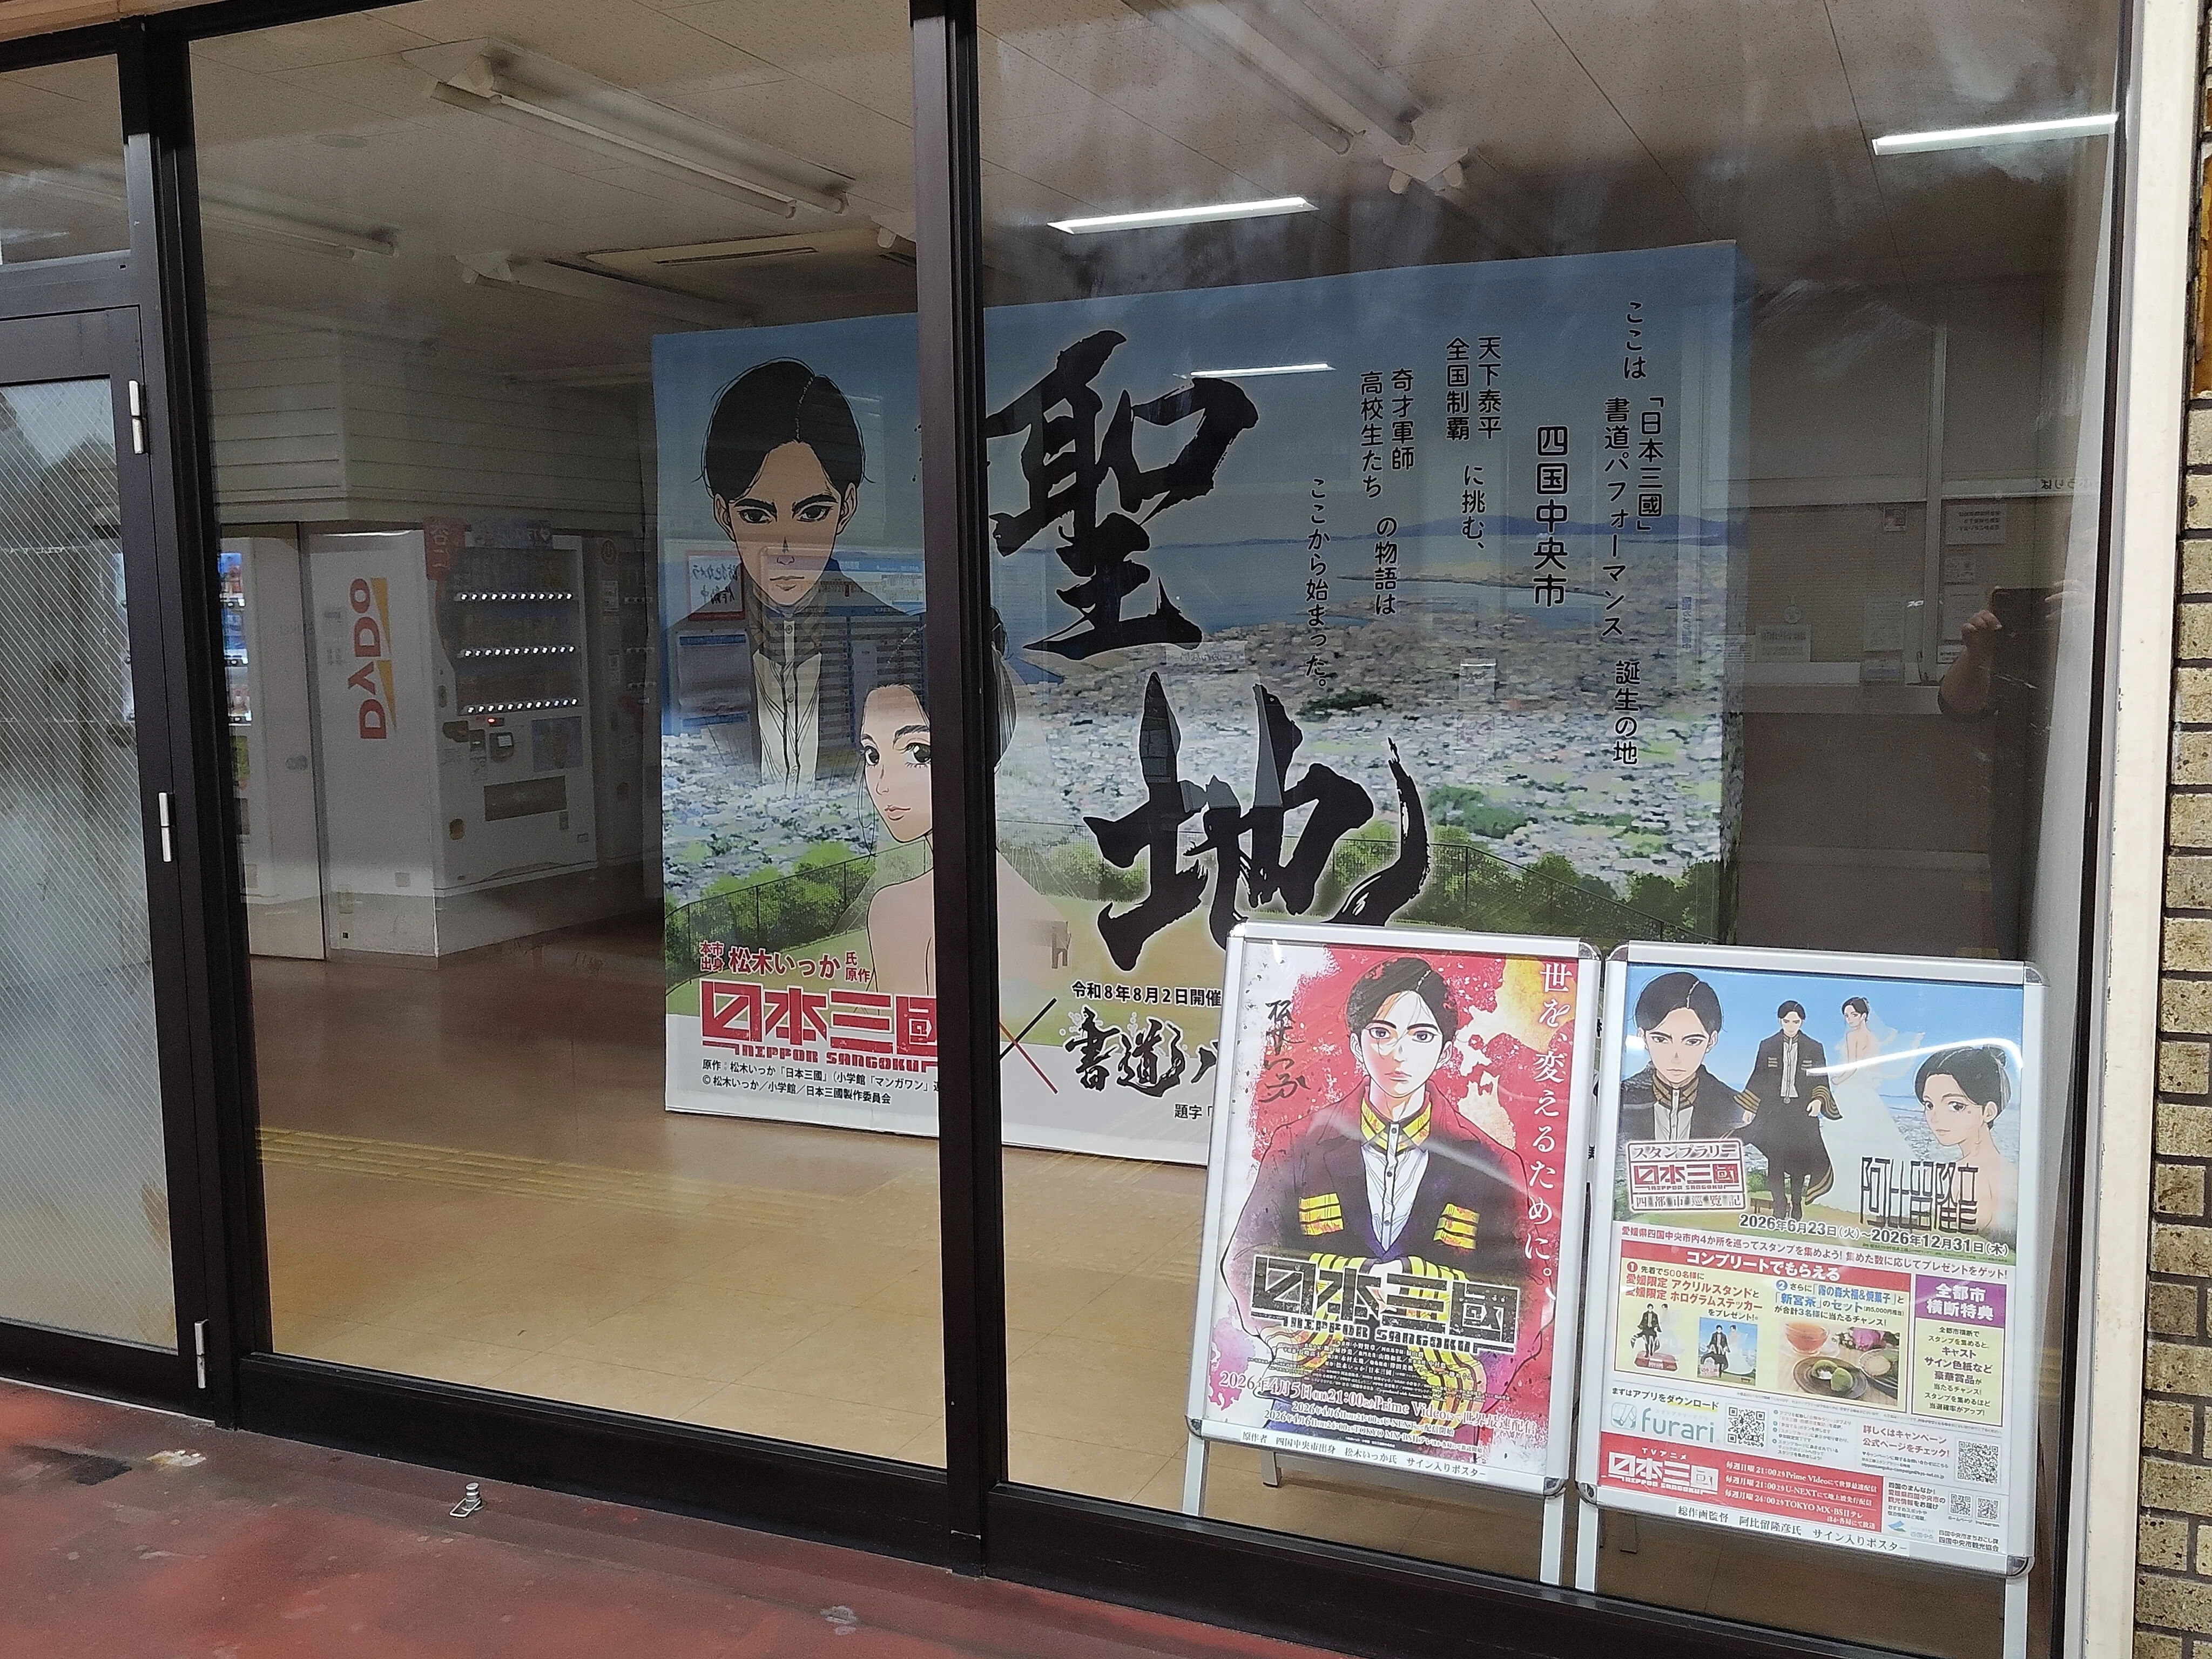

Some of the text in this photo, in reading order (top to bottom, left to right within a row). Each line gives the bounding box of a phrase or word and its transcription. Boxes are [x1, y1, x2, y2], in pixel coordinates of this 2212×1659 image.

[1623, 302, 1647, 380] ここは
[1446, 336, 1471, 442] 全国制覇
[1478, 336, 1502, 440] 天下泰平
[1391, 367, 1414, 471] 奇才軍師
[1360, 370, 1384, 499] 高校生たち
[1637, 396, 1664, 533] 「日本三國」
[1461, 465, 1486, 550] に挑む、
[1533, 425, 1569, 608] 四国中央市
[1602, 397, 1630, 637] 書道パフォーマンス
[1373, 516, 1399, 616] の物語は
[1304, 478, 1329, 689] ここから始まった。
[1613, 660, 1641, 765] 誕生の地
[700, 941, 724, 955] 本市
[845, 951, 858, 966] 氏
[700, 956, 724, 972] 出身
[729, 948, 840, 980] 松木いっか
[845, 967, 871, 983] 原作
[1072, 981, 1222, 1006] 令和8年8月2日開催
[743, 1044, 818, 1063] NIPPON
[1525, 962, 1574, 1277] 世を、変えるために。
[1633, 1144, 1736, 1159] スタンプラリー
[1636, 1195, 1742, 1208] 四都市巡覧記
[1641, 1265, 1705, 1279] 先着で500名様に
[1687, 1250, 1840, 1281] コンプリートでもらえる
[1627, 1274, 1759, 1298] 愛媛限定 アクリルスタンドと
[1936, 1283, 1986, 1303] 全都市
[1670, 1292, 1763, 1311] ホログラムステッカー
[1927, 1299, 1994, 1322] 横断特典
[1924, 1357, 1993, 1374] サイン色紙など
[1941, 1346, 1977, 1359] キャスト
[1612, 1387, 1719, 1411] まずはアプリをダウンロード
[1641, 1407, 1715, 1444] furari
[1863, 1425, 1947, 1444] 詳しくはキャンペーン
[1243, 1432, 1267, 1443] 原作者
[1276, 1437, 1336, 1454] 四国中央市出身
[1345, 1447, 1398, 1464] 松木いっか氏
[1407, 1458, 1486, 1477] サイン入りポスター
[1642, 1447, 1687, 1460] TVアニメ
[1678, 1505, 1729, 1523] 総作画監督
[1813, 1529, 1907, 1552] サイン入りポスター
